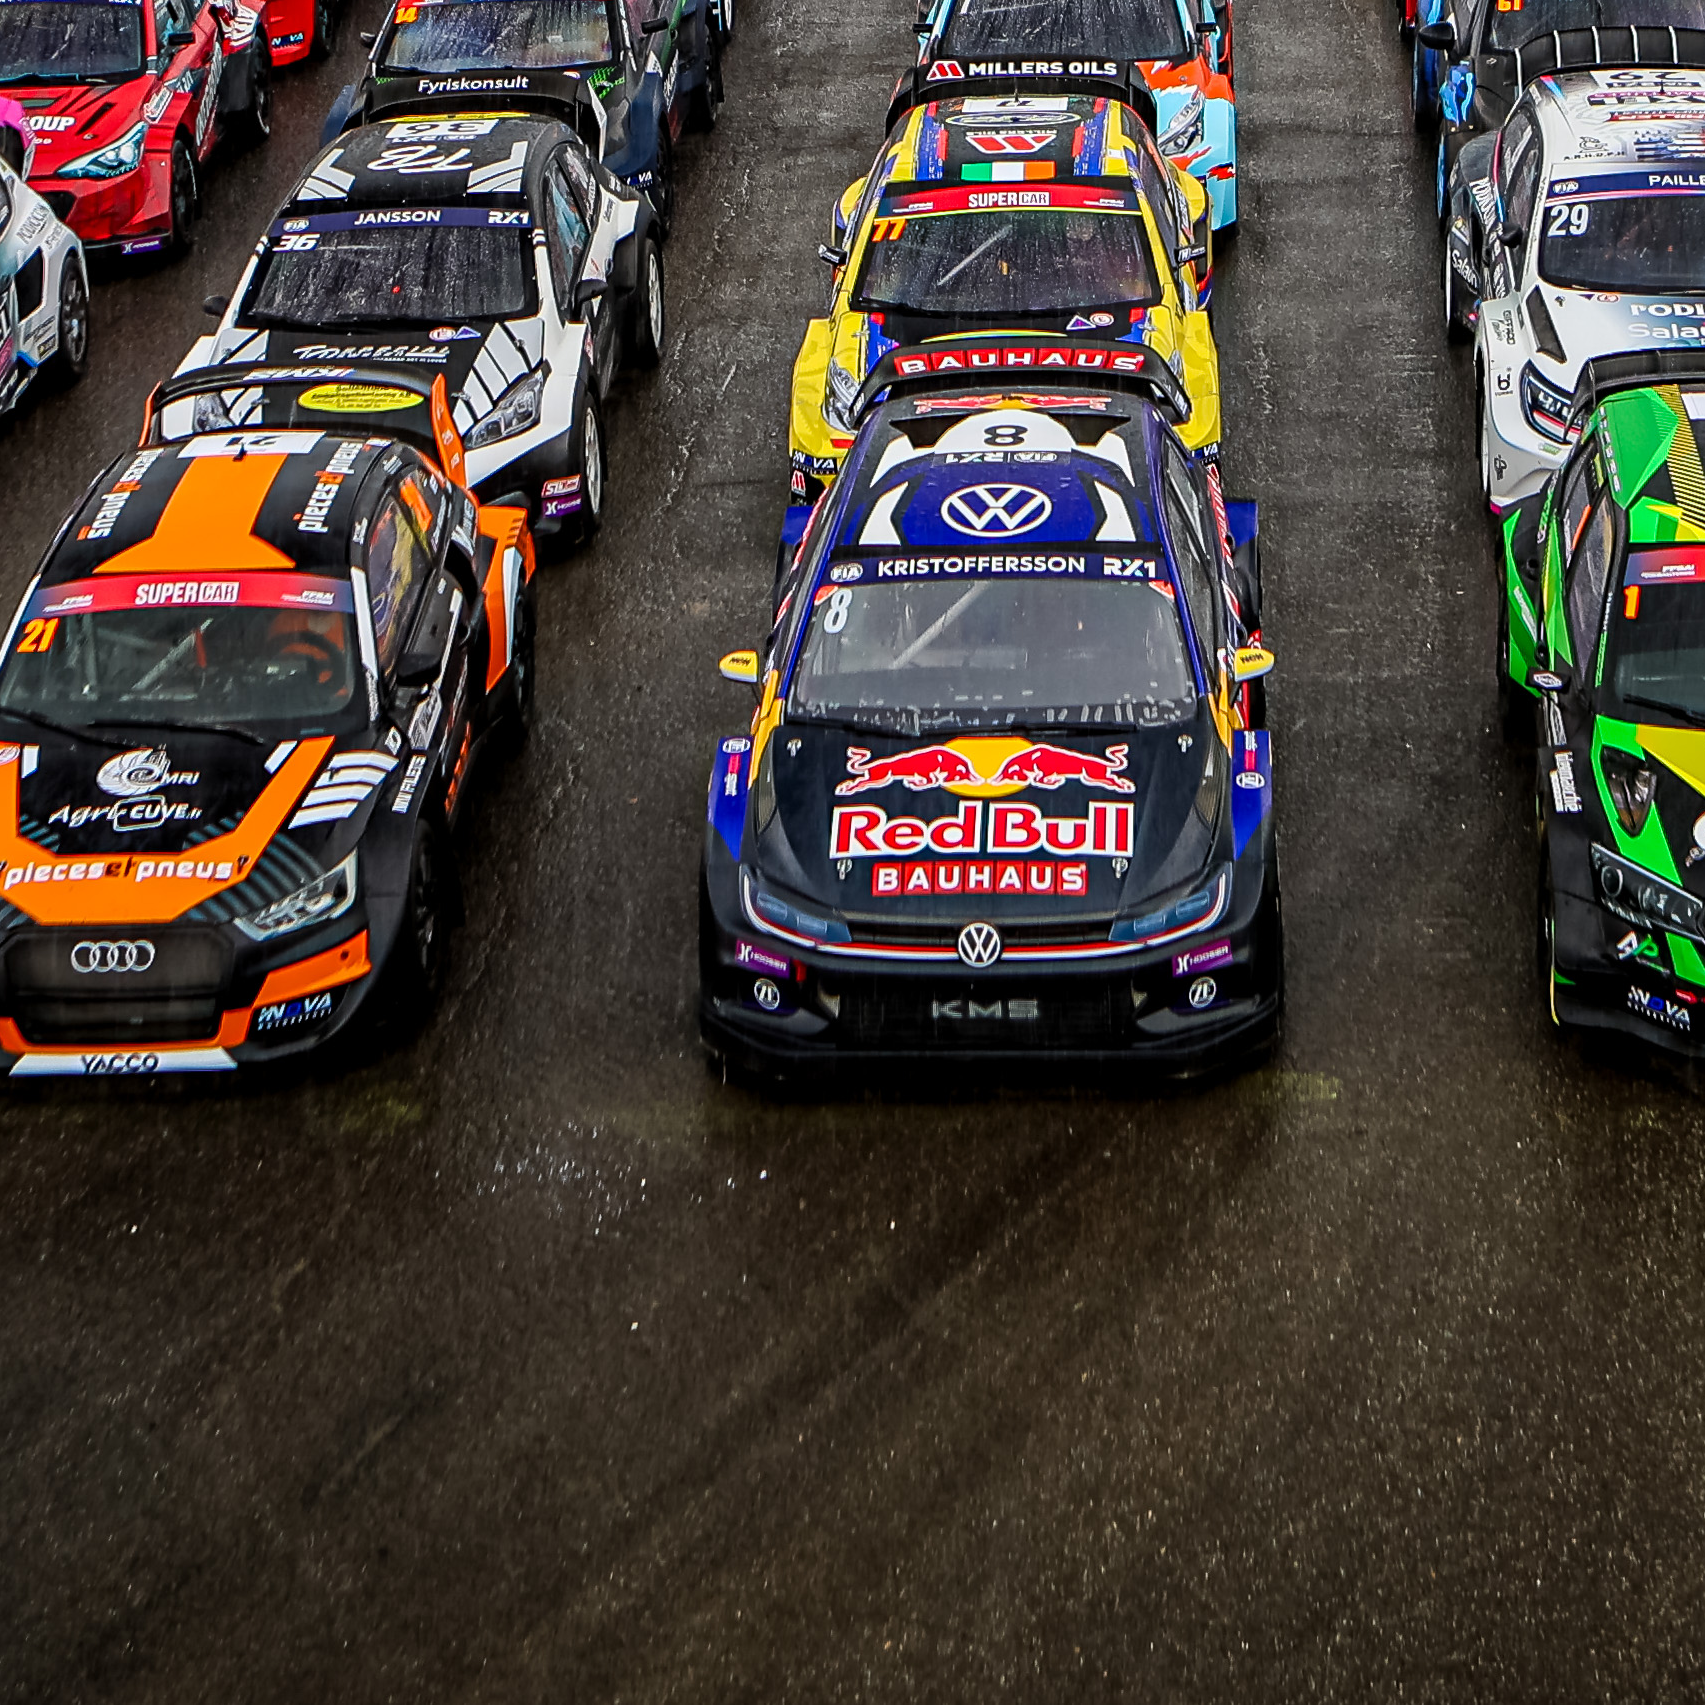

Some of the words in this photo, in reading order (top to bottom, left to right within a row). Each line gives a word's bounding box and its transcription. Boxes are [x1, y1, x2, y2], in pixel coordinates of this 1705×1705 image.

[396, 7, 418, 24] 14
[969, 61, 1064, 76] MILLERS
[1069, 61, 1117, 76] OILS
[418, 75, 529, 93] Fyriskonsult
[353, 210, 441, 225] JANSSON
[488, 210, 531, 224] RX1
[1548, 204, 1590, 236] 29
[872, 218, 905, 242] 77
[273, 234, 321, 251] 36
[901, 349, 1143, 375] BAUHAUS
[982, 425, 1028, 446] 8
[831, 565, 862, 579] FIA
[877, 556, 1086, 576] KRISTOFFERSSON
[1102, 556, 1157, 578] RX1
[823, 587, 852, 634] 8
[1624, 586, 1641, 619] 1
[17, 617, 60, 653] 21
[166, 770, 198, 786] MRI
[829, 800, 982, 860] Red
[987, 802, 1135, 857] Bull
[876, 866, 1085, 893] BAUHAUS
[931, 999, 1038, 1019] KMS
[81, 1053, 158, 1073] YACCO
